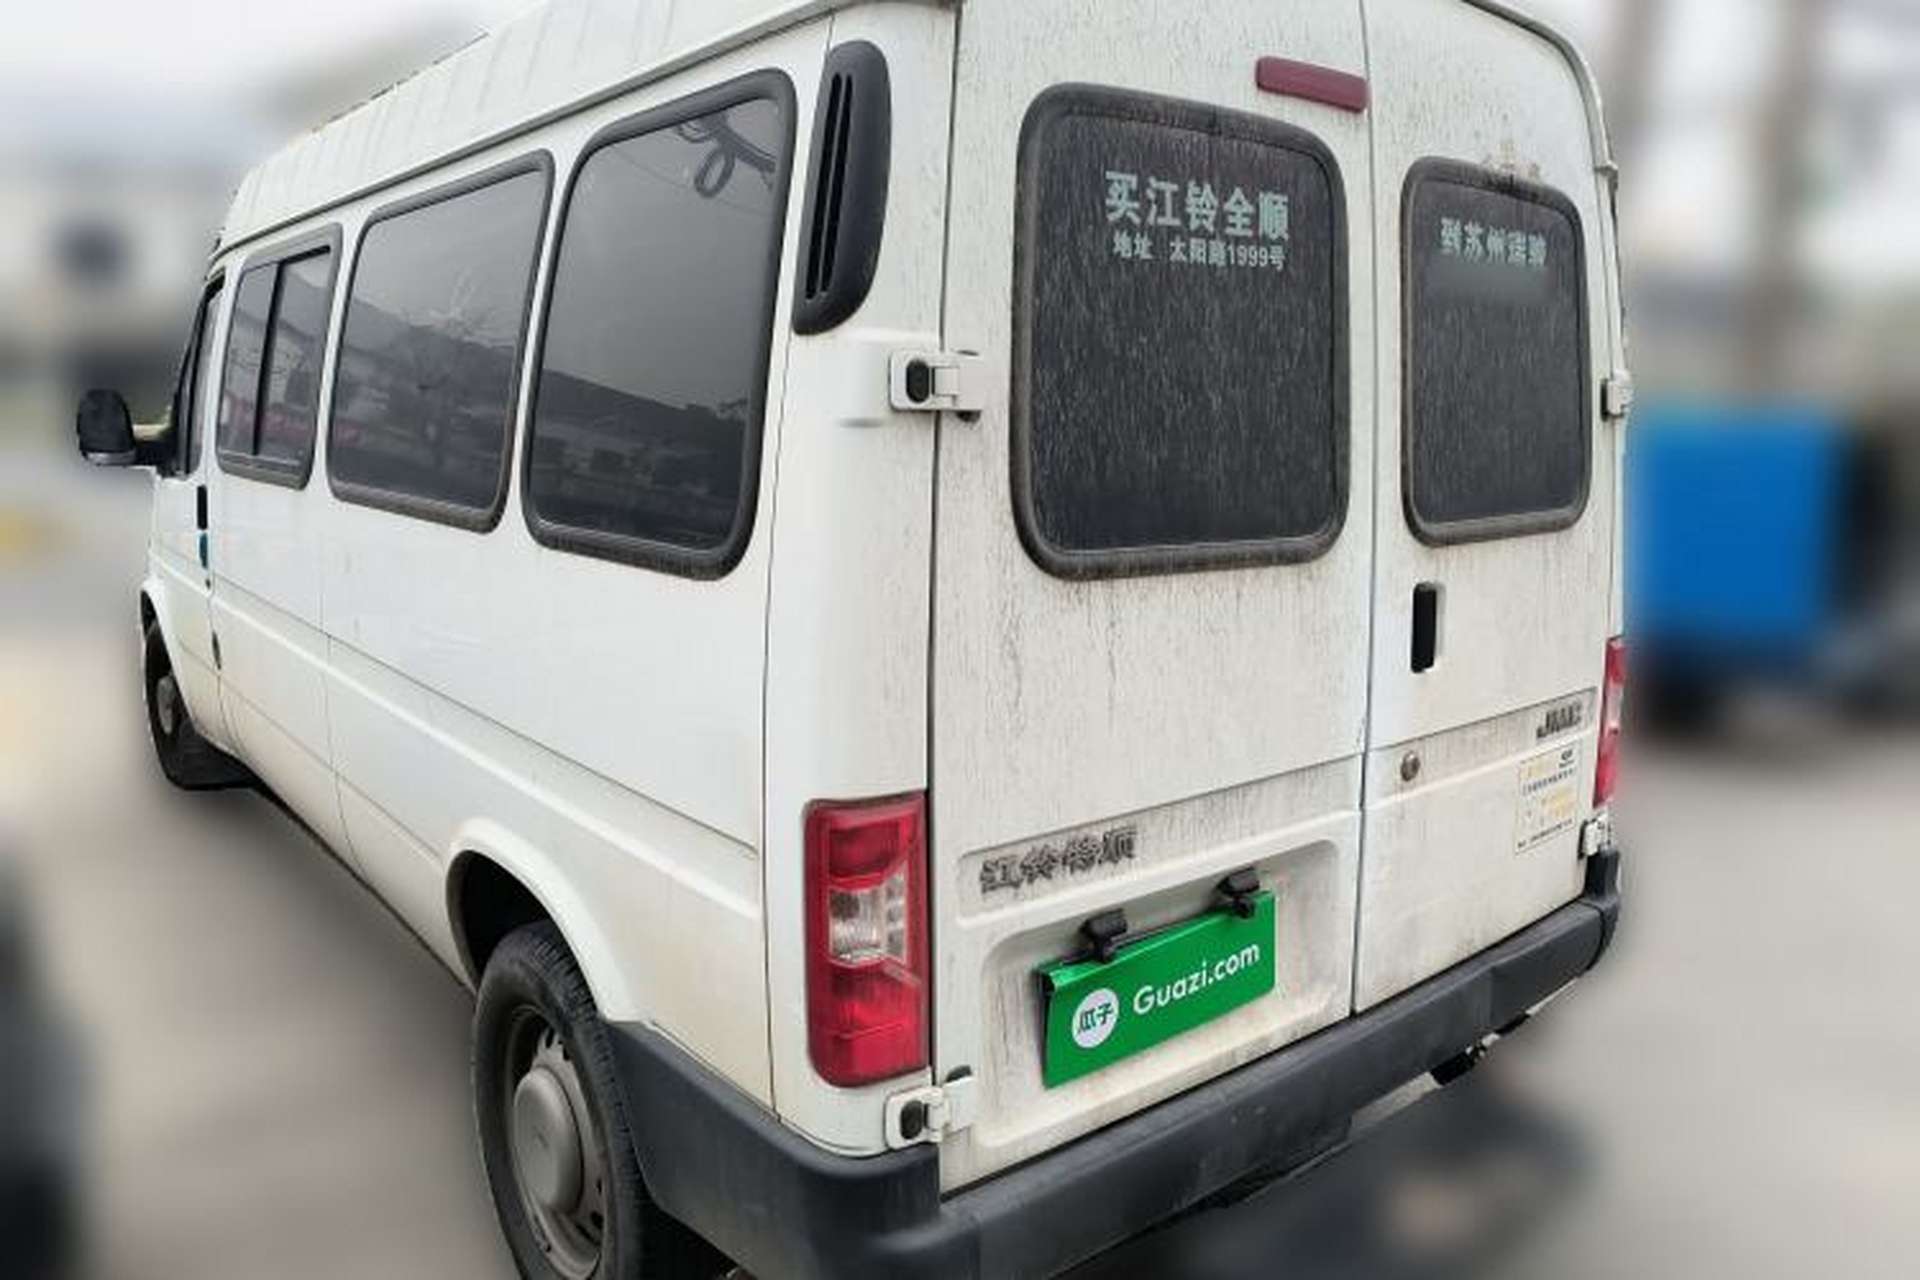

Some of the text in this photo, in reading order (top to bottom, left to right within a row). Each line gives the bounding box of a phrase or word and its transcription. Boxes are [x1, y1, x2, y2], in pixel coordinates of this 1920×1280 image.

[1105, 171, 1289, 241] 买江铃全顺
[1113, 229, 1285, 270] 地址 太阳路1999号
[1133, 944, 1261, 1015] Guazi.com
[1077, 1001, 1115, 1034] 瓜子
